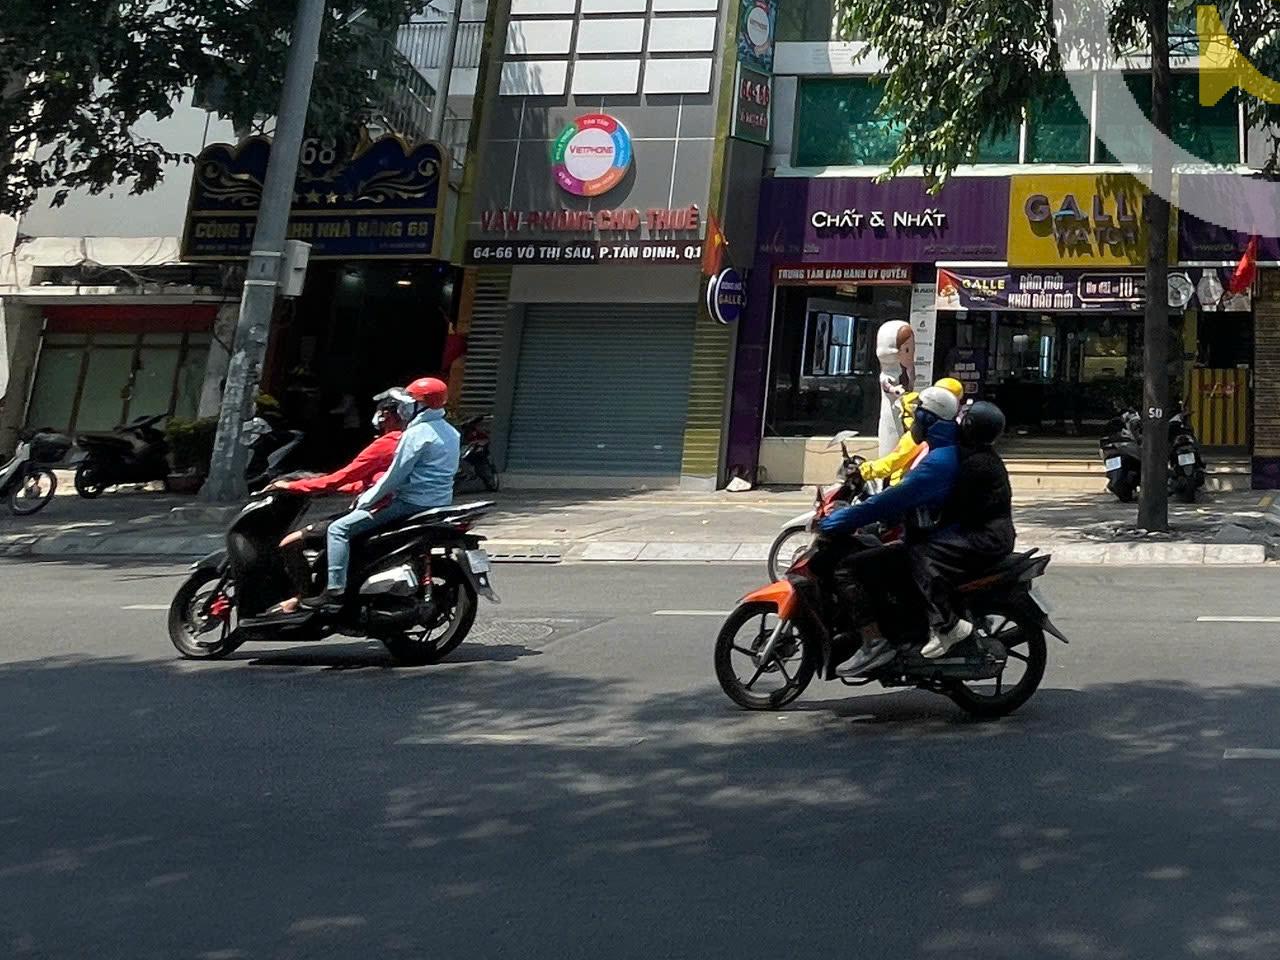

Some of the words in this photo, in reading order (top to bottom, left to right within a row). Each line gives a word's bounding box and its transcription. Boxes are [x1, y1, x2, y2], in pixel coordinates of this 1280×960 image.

[302, 138, 336, 165] 68
[569, 145, 613, 154] VIETPHONE
[1024, 194, 1149, 222] GALL
[598, 208, 641, 231] CHO
[647, 204, 699, 231] THUÊ
[869, 211, 885, 228] &
[473, 246, 513, 259] 64-66
[962, 279, 1005, 290] GALLE
